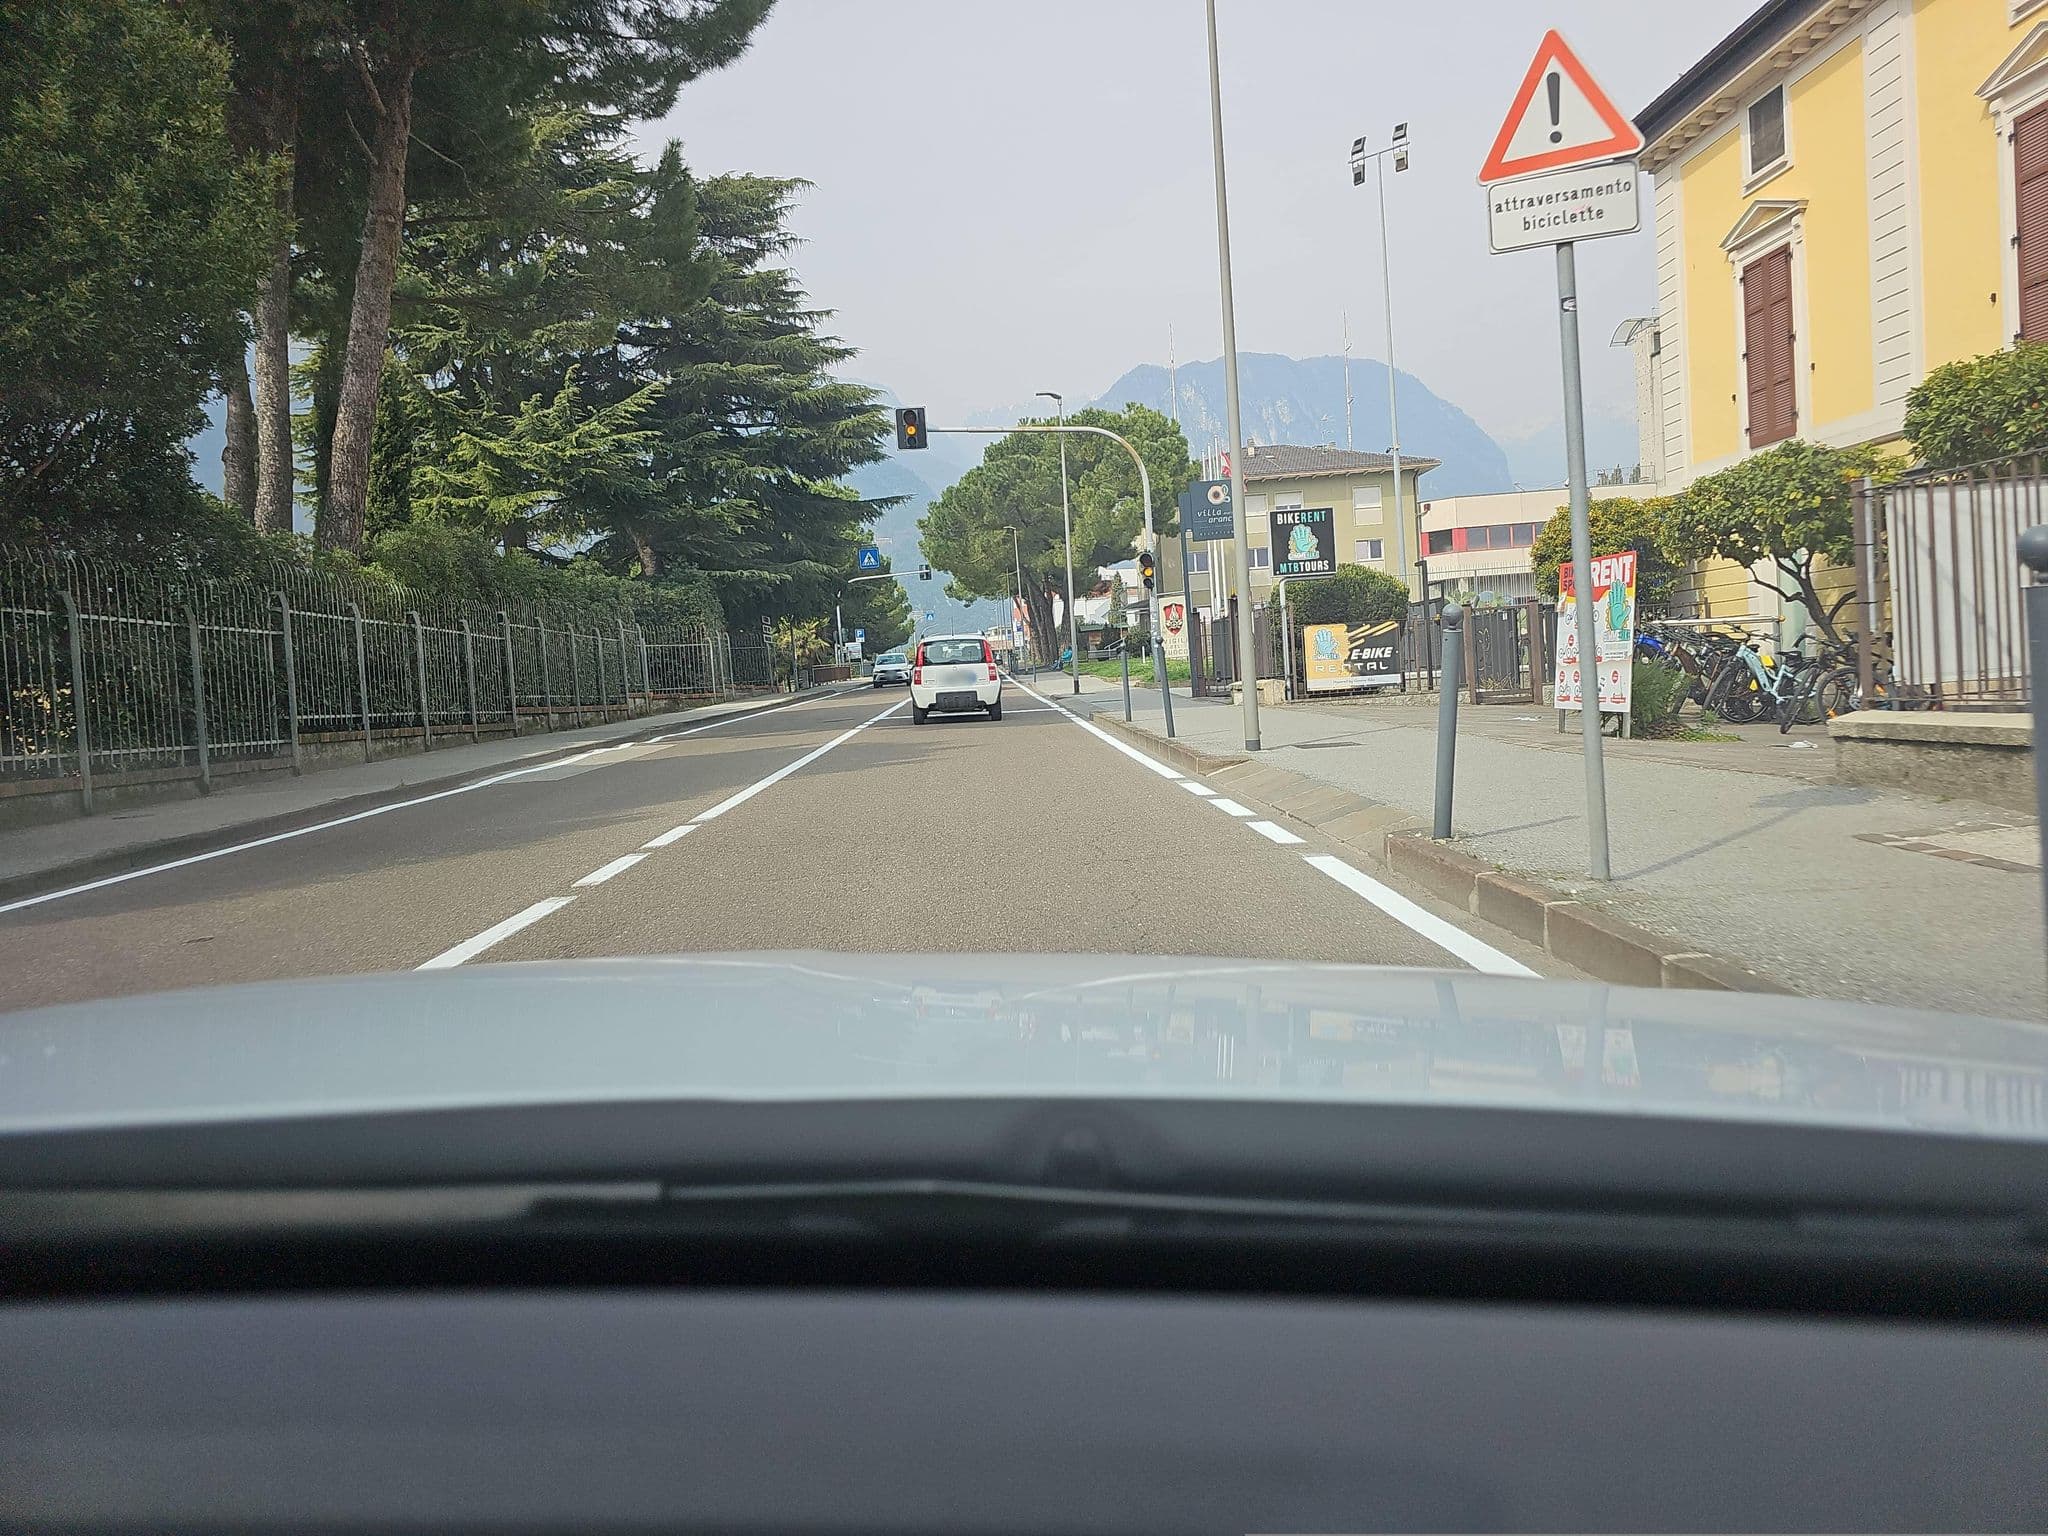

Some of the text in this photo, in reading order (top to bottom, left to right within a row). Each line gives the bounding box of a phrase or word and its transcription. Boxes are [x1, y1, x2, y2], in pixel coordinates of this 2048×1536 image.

[1495, 178, 1632, 214] attraversamento
[1523, 206, 1604, 231] biciclette
[1208, 515, 1233, 524] aranc
[1590, 554, 1634, 588] RENT
[1350, 646, 1394, 660] E-BIKE
